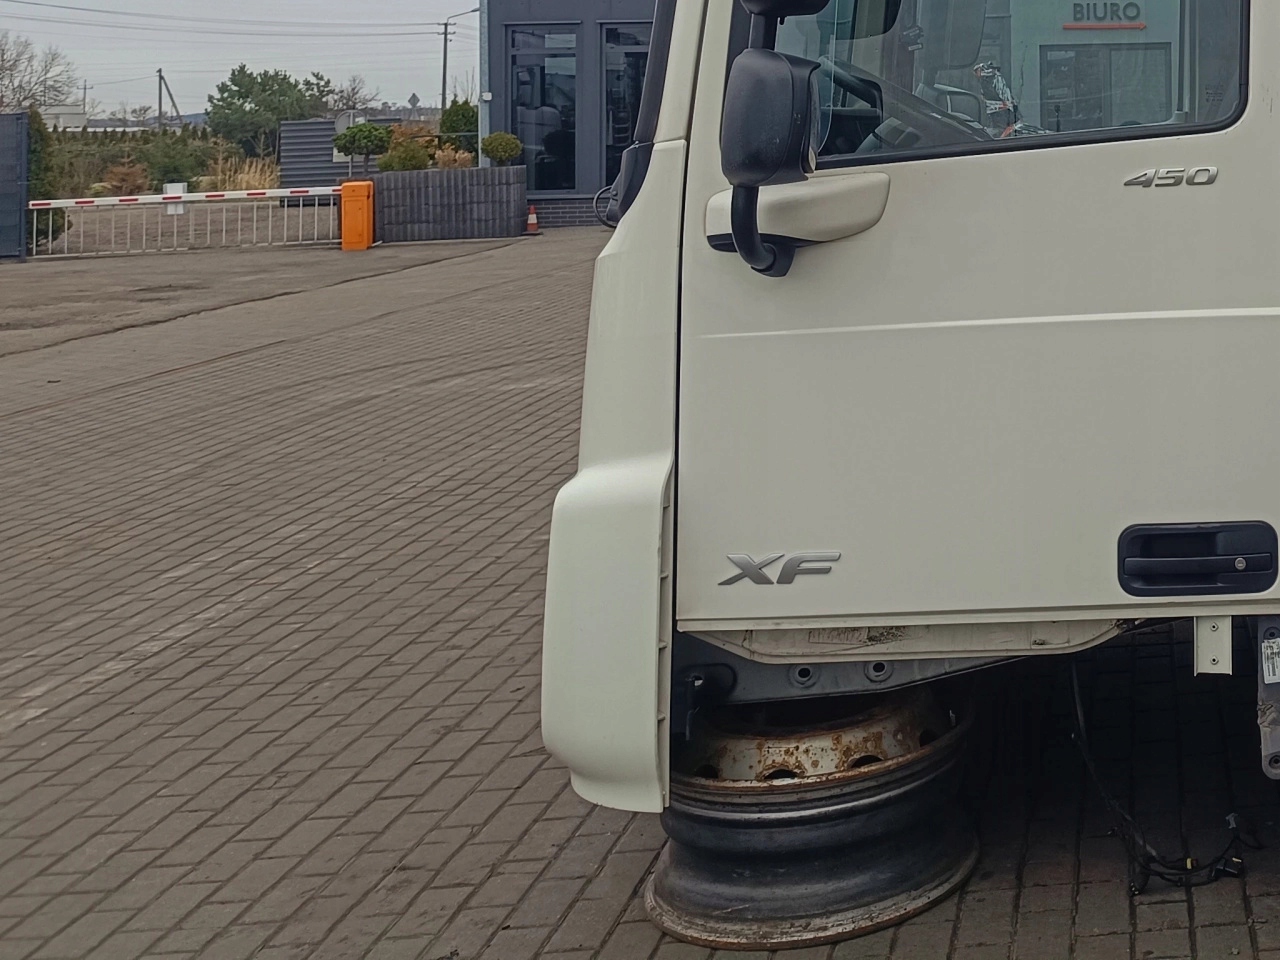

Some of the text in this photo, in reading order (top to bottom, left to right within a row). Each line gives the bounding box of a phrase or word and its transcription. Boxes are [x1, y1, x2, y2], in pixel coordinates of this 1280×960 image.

[1073, 1, 1141, 21] BIURO
[1123, 166, 1219, 188] 450
[717, 551, 842, 586] XF
